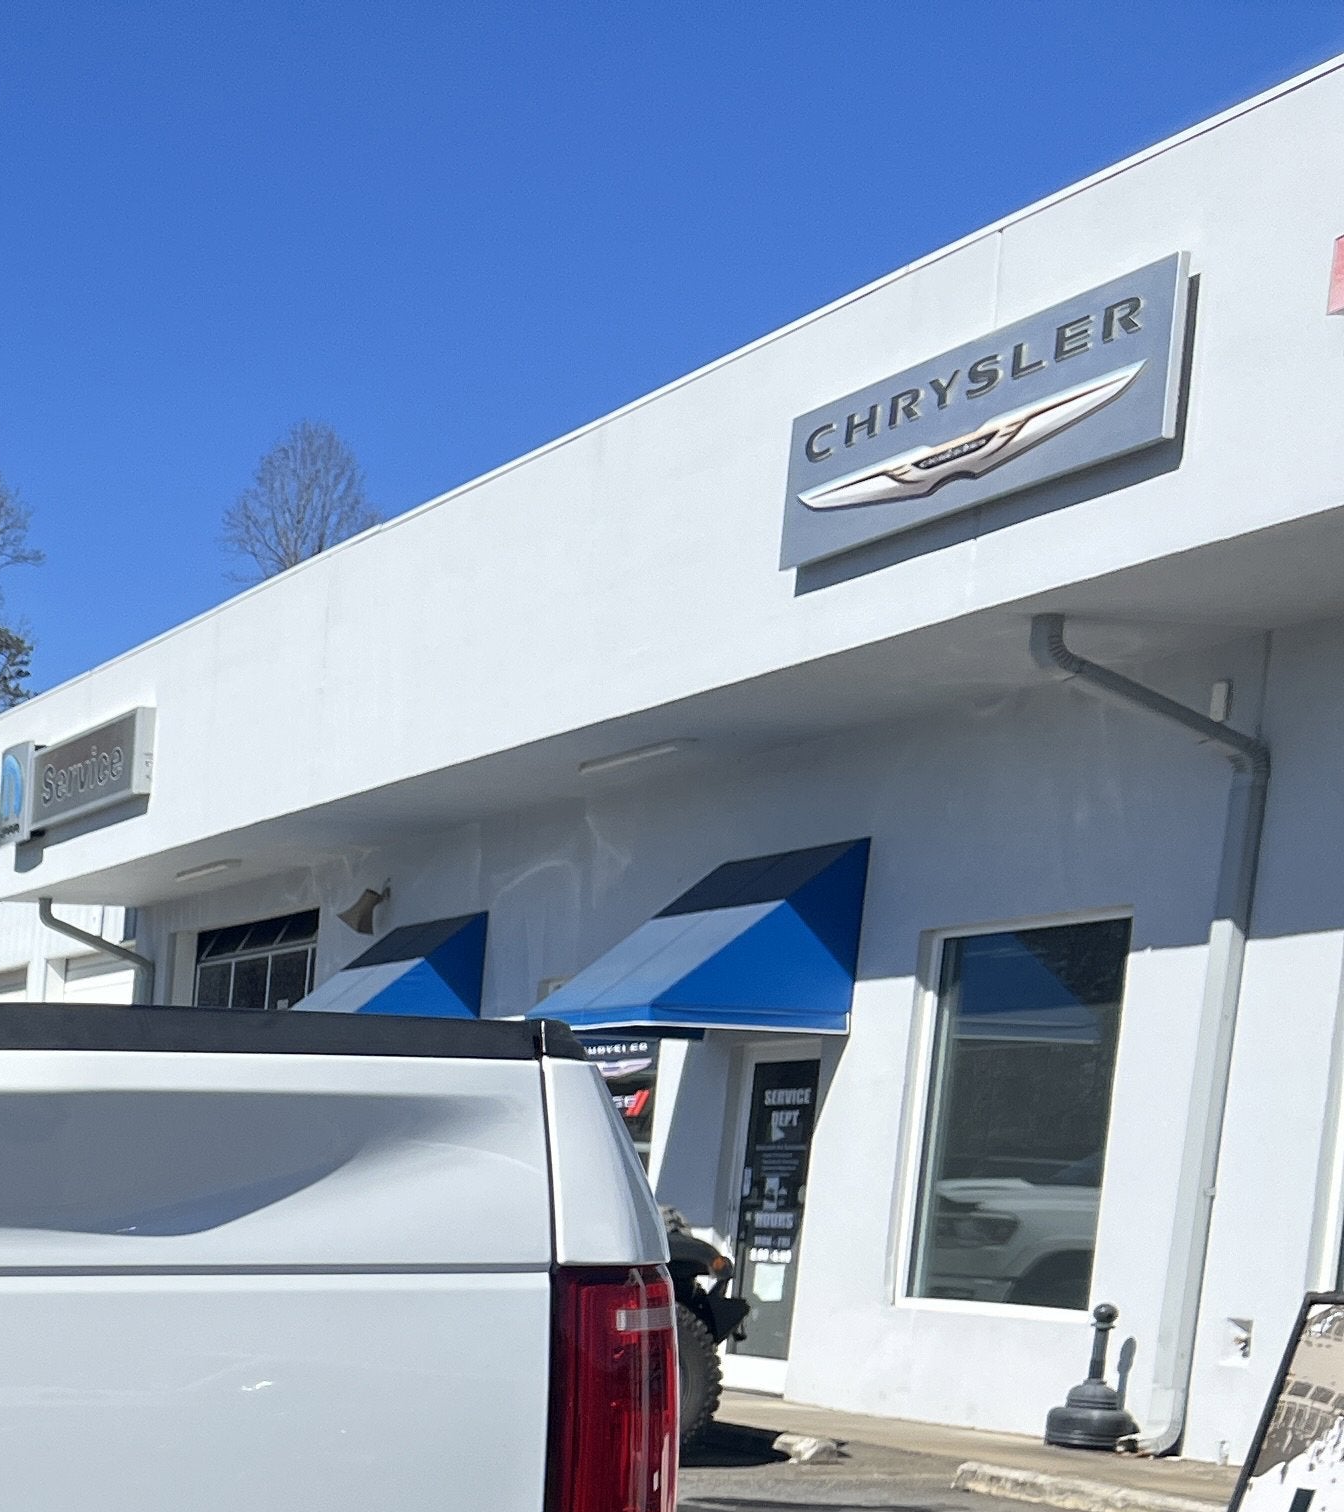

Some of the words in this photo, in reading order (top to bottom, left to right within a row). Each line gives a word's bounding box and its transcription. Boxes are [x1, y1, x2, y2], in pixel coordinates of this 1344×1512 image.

[805, 296, 1144, 464] CHRYSLER
[42, 745, 124, 808] Service
[764, 1087, 812, 1106] SERVICE
[771, 1109, 800, 1127] DEPT
